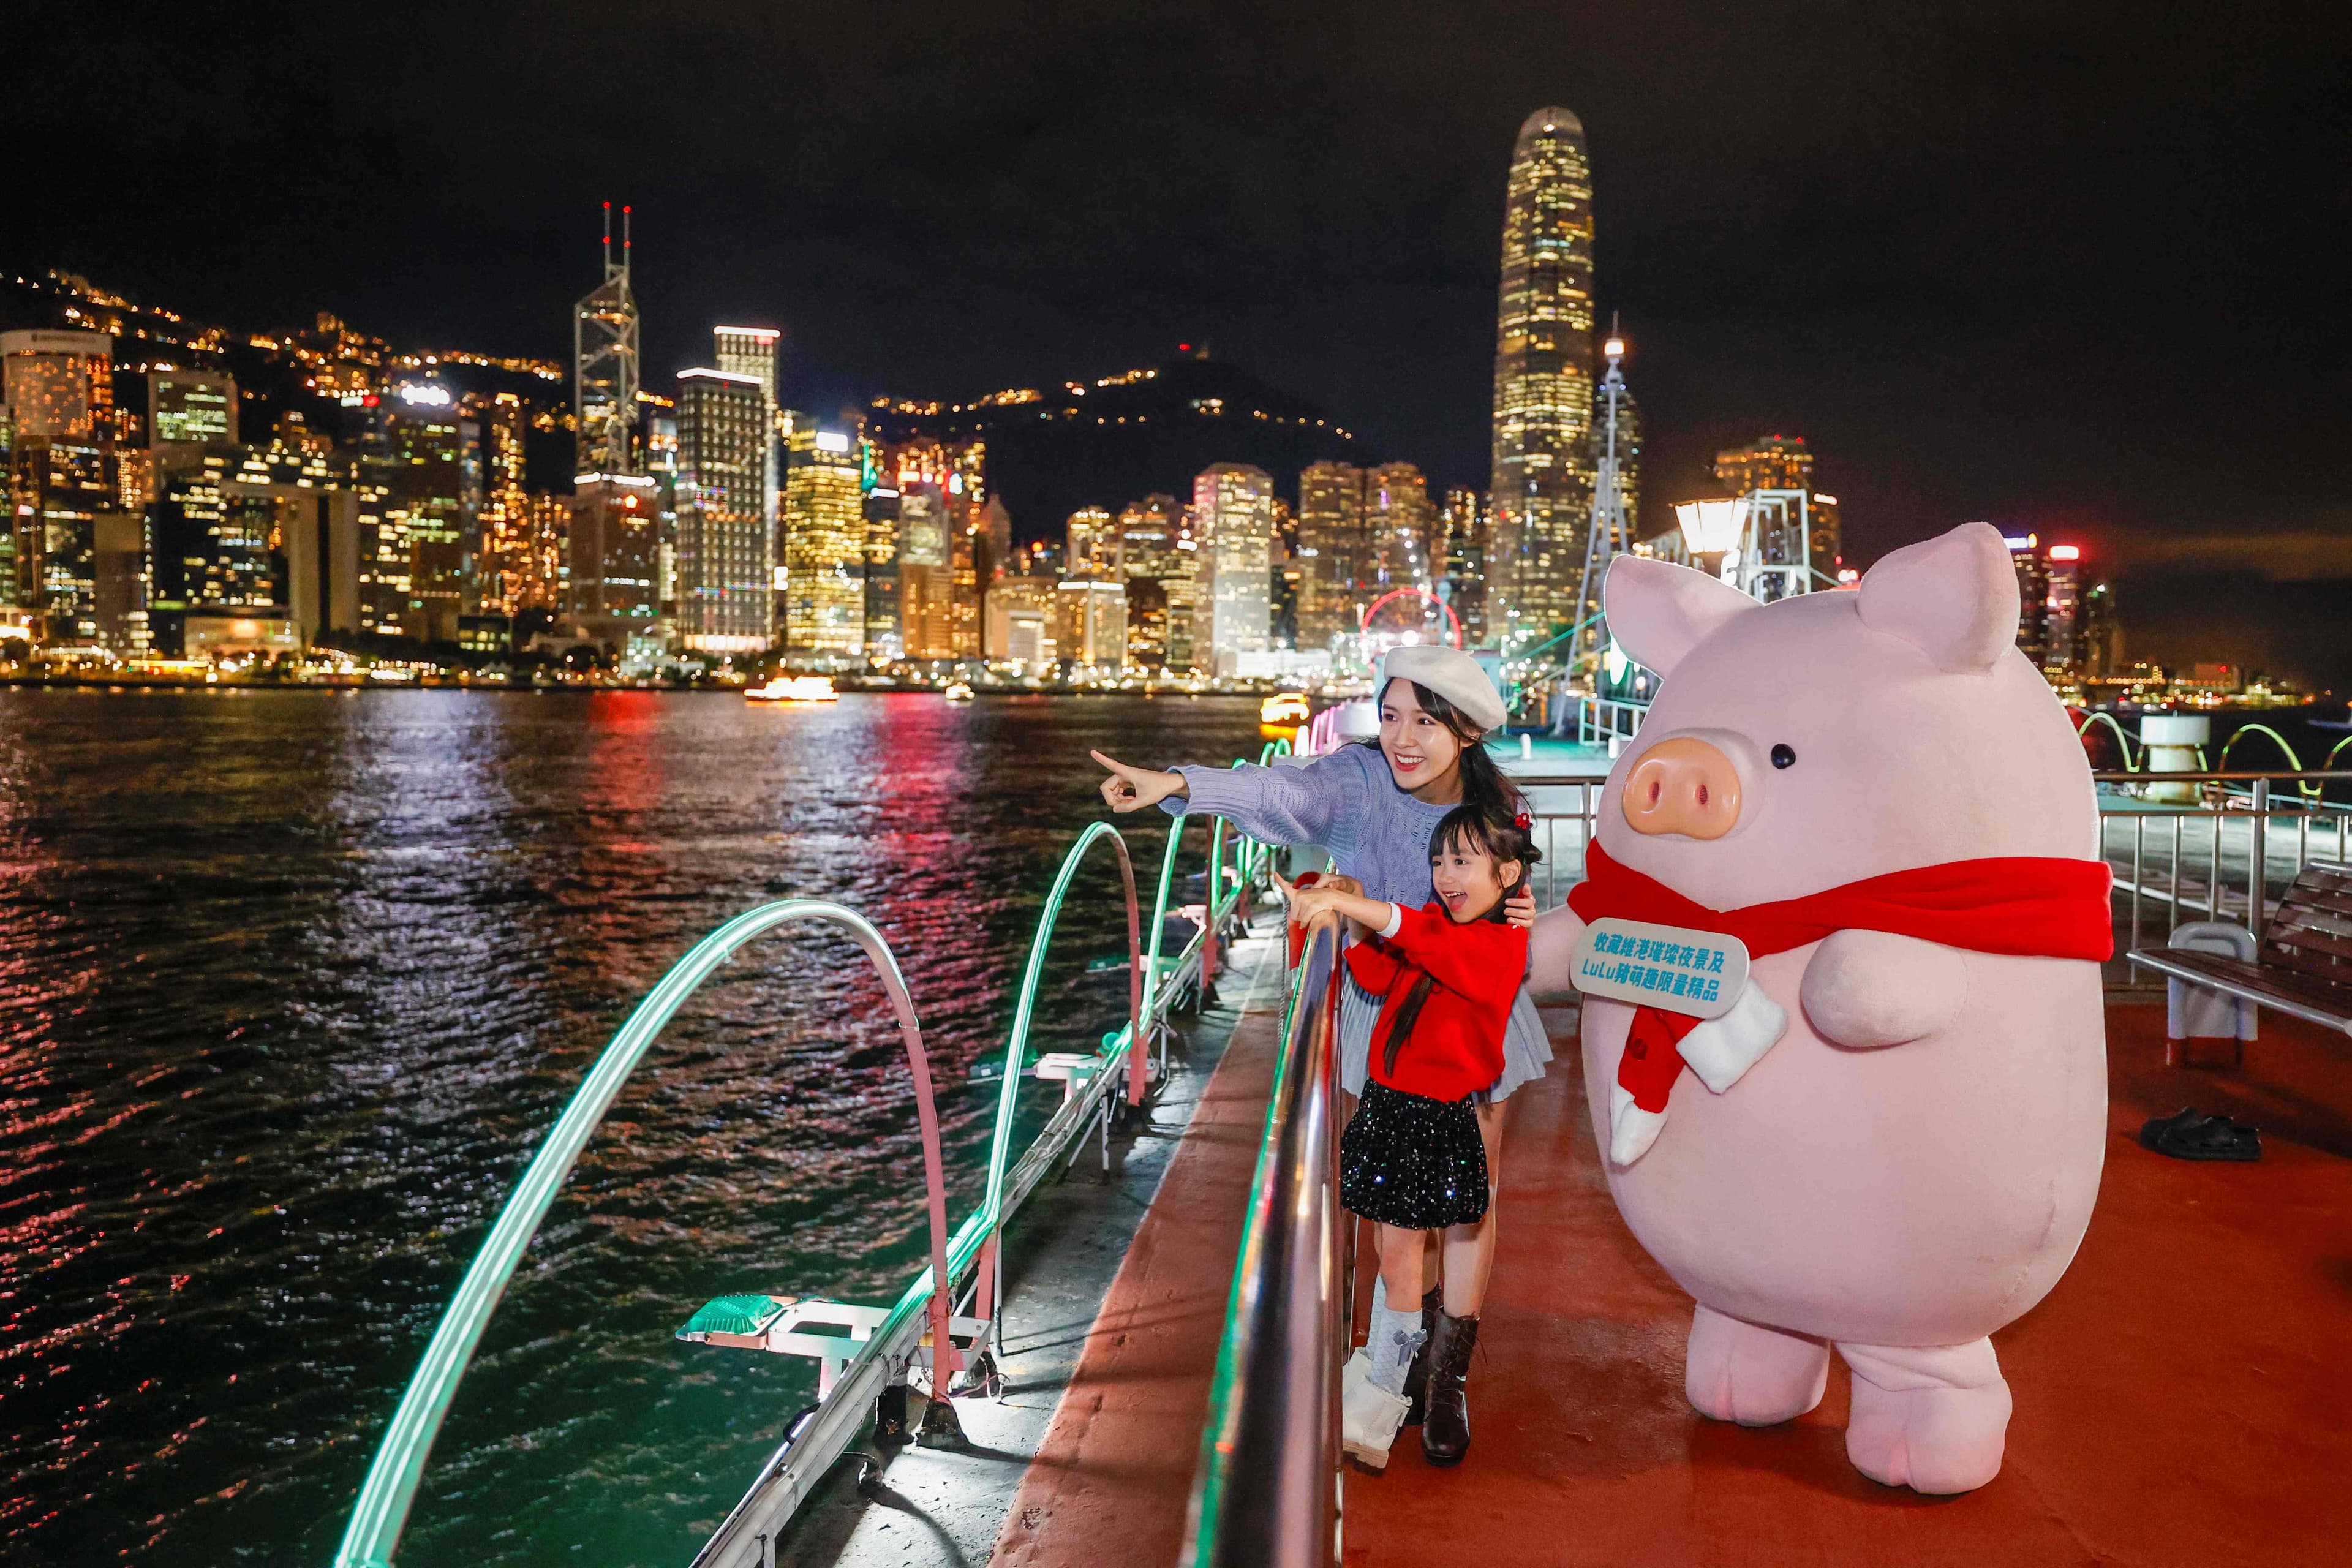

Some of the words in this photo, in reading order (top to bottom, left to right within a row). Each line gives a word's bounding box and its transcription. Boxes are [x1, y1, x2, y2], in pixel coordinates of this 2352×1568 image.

[1594, 932, 1725, 974] 收藏維港璀璨夜景及
